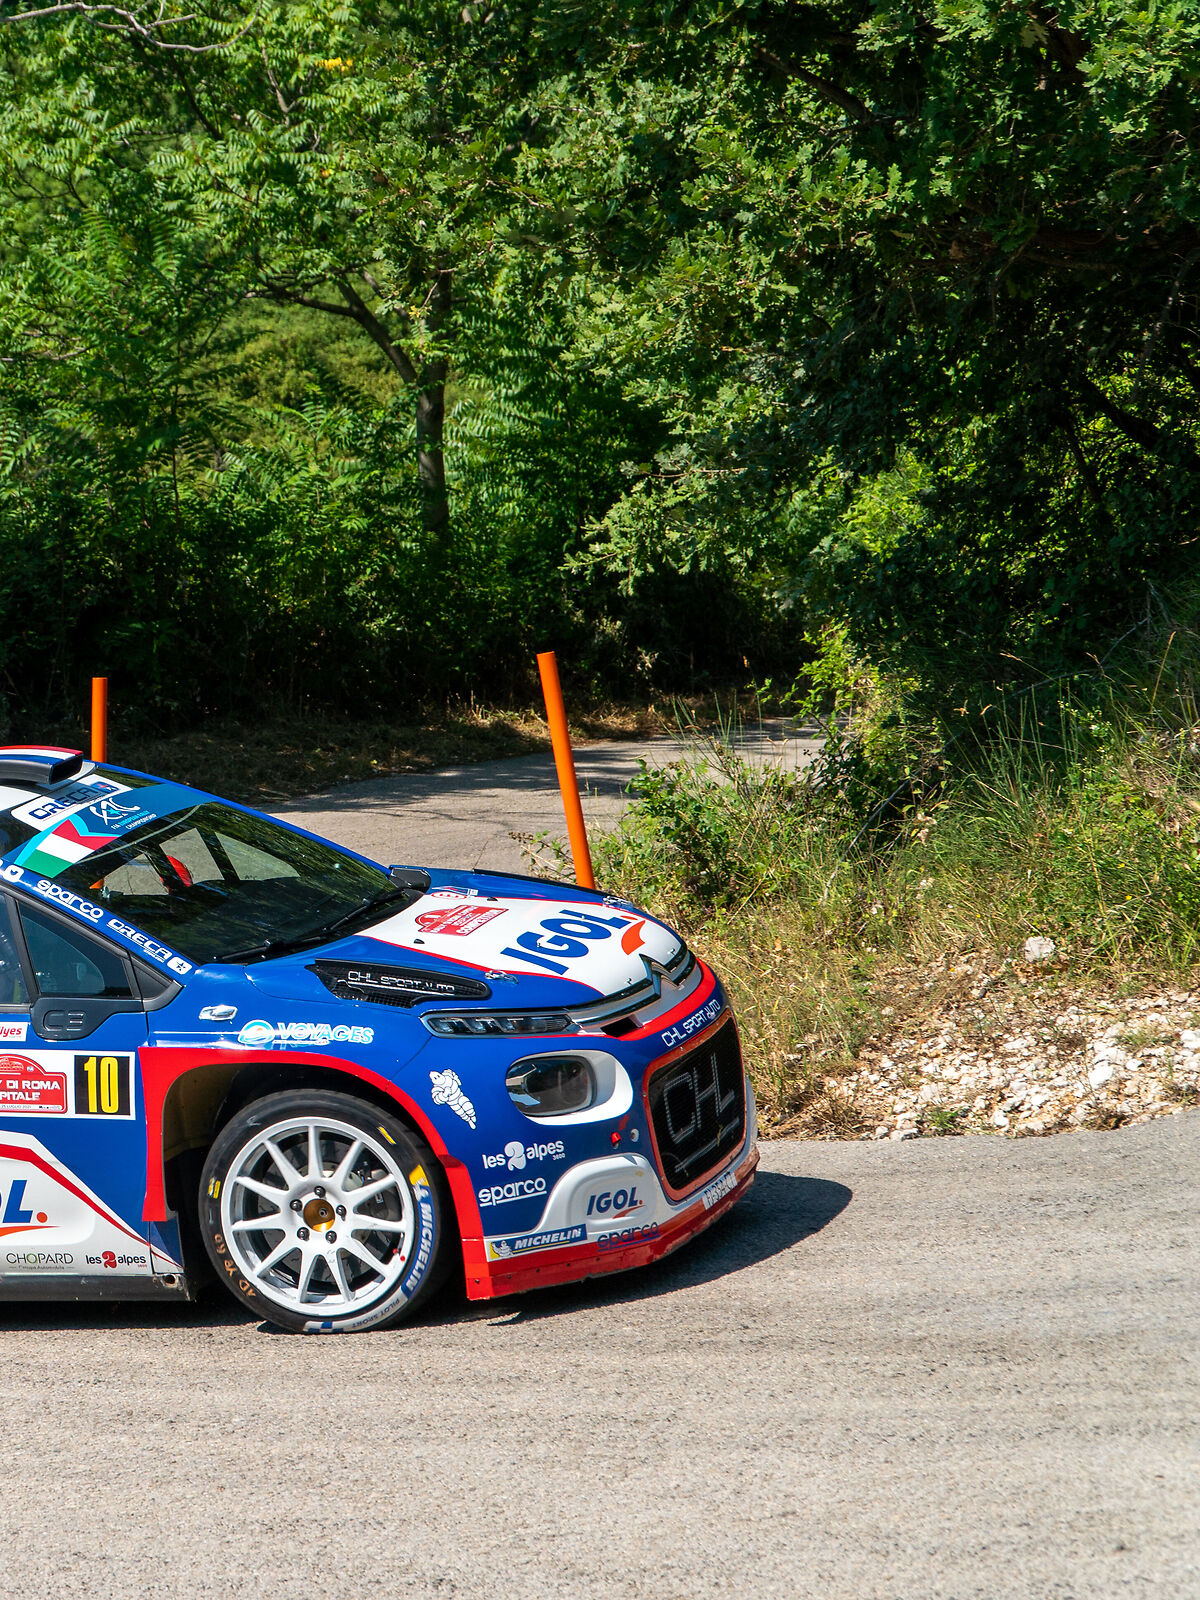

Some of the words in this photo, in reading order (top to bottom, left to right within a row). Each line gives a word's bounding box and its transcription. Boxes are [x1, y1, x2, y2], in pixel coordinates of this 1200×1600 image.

[28, 786, 98, 820] ORECA
[33, 880, 104, 924] sparco
[106, 918, 173, 959] ORECA
[348, 970, 379, 984] CHL
[380, 976, 421, 990] SPORT
[277, 1022, 374, 1044] VOYAGES
[661, 1027, 687, 1047] CHL
[683, 1009, 707, 1033] SPORT
[6, 1080, 19, 1089] DI
[22, 1080, 61, 1091] ROMA
[84, 1056, 118, 1114] 10
[482, 1153, 506, 1170] les
[526, 1140, 565, 1161] alpes
[478, 1178, 547, 1207] sparco
[406, 1203, 434, 1292] MICHELIN
[514, 1227, 583, 1250] MICHELIN
[597, 1221, 662, 1252] sparco
[6, 1252, 74, 1265] CHOPARD
[85, 1254, 102, 1265] les
[117, 1254, 147, 1266] alpes
